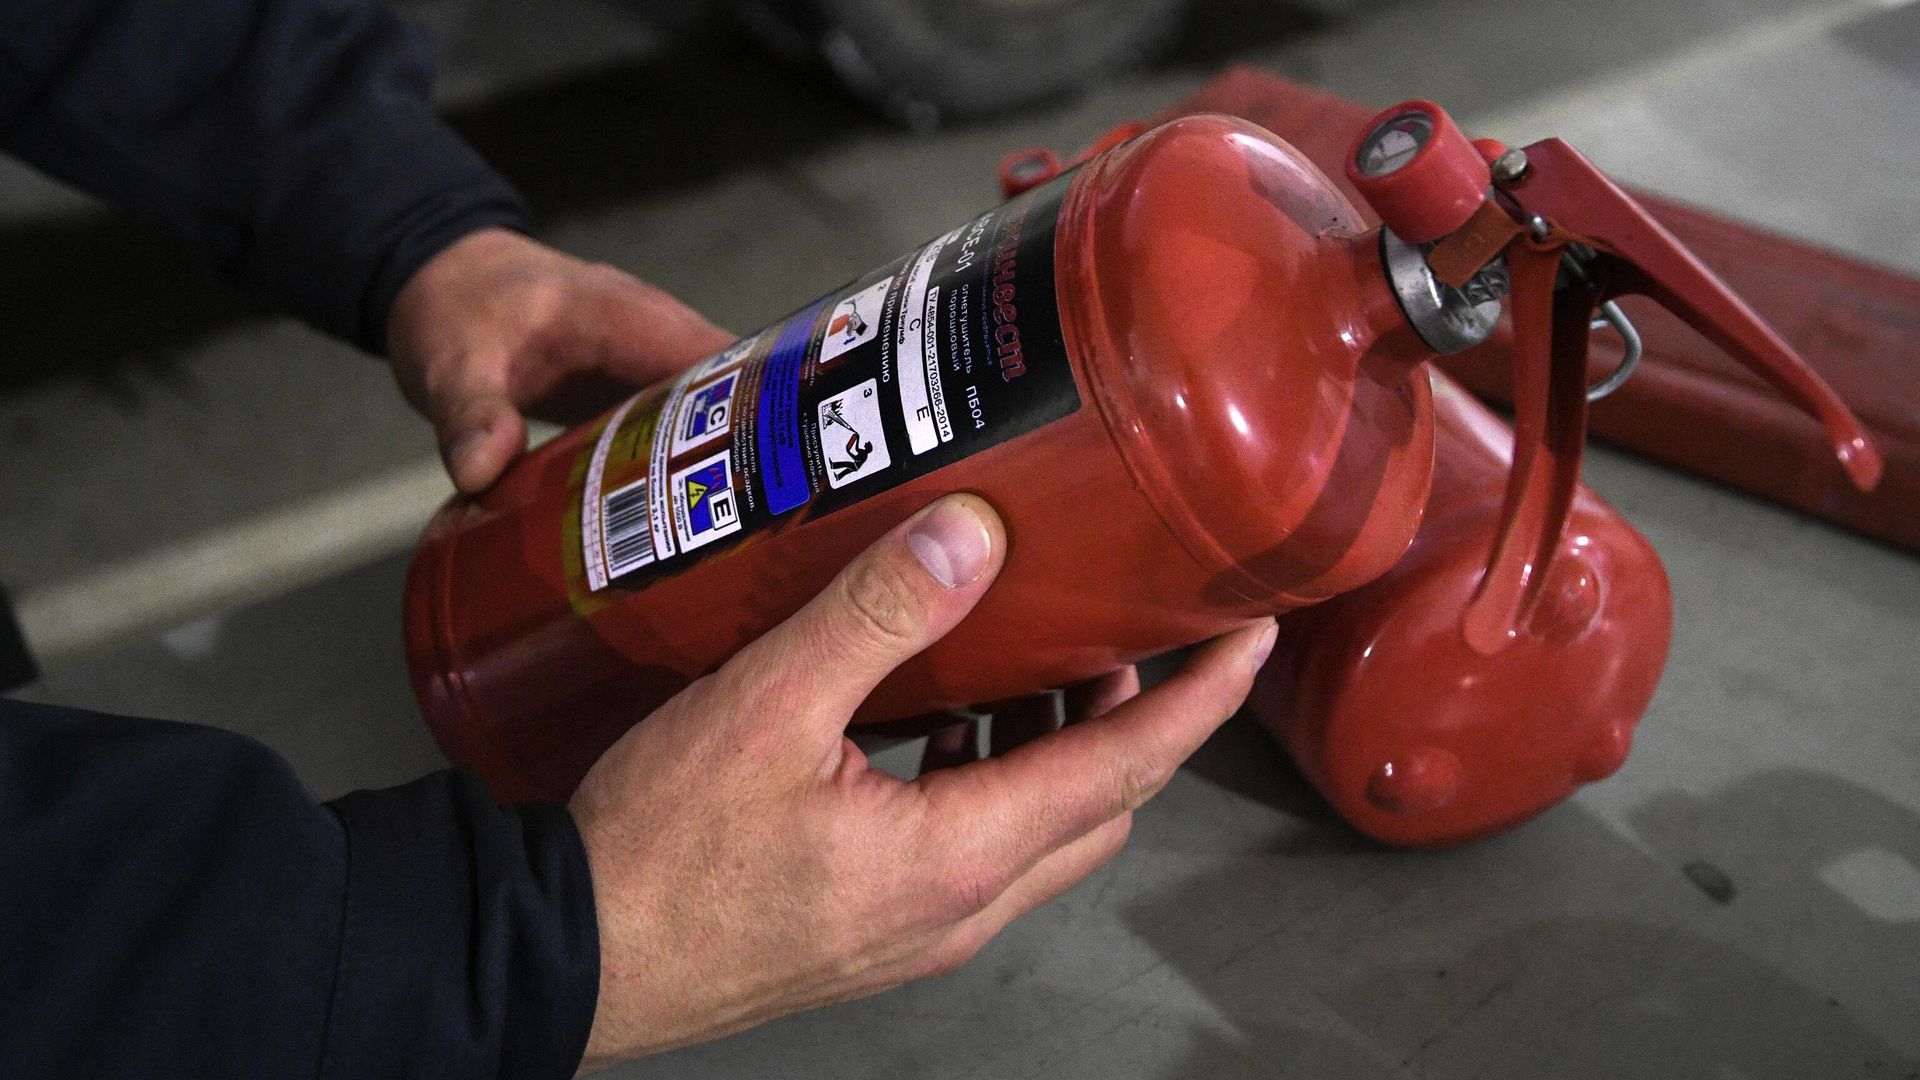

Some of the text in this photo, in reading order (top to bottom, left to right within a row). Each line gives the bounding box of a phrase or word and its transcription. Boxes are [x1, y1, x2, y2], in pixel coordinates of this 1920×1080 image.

[881, 291, 898, 383] применению
[898, 308, 909, 345] Триумф
[948, 288, 962, 372] порошковый
[909, 318, 930, 421] С Е
[926, 290, 951, 438] ТУ 4854-001-21703266-2014
[959, 283, 986, 429] огнетушитель ПБ04
[710, 405, 726, 426] С
[863, 387, 873, 398] 3
[810, 422, 822, 475] Приступить
[808, 459, 820, 493] пожара
[713, 497, 732, 522] Е
